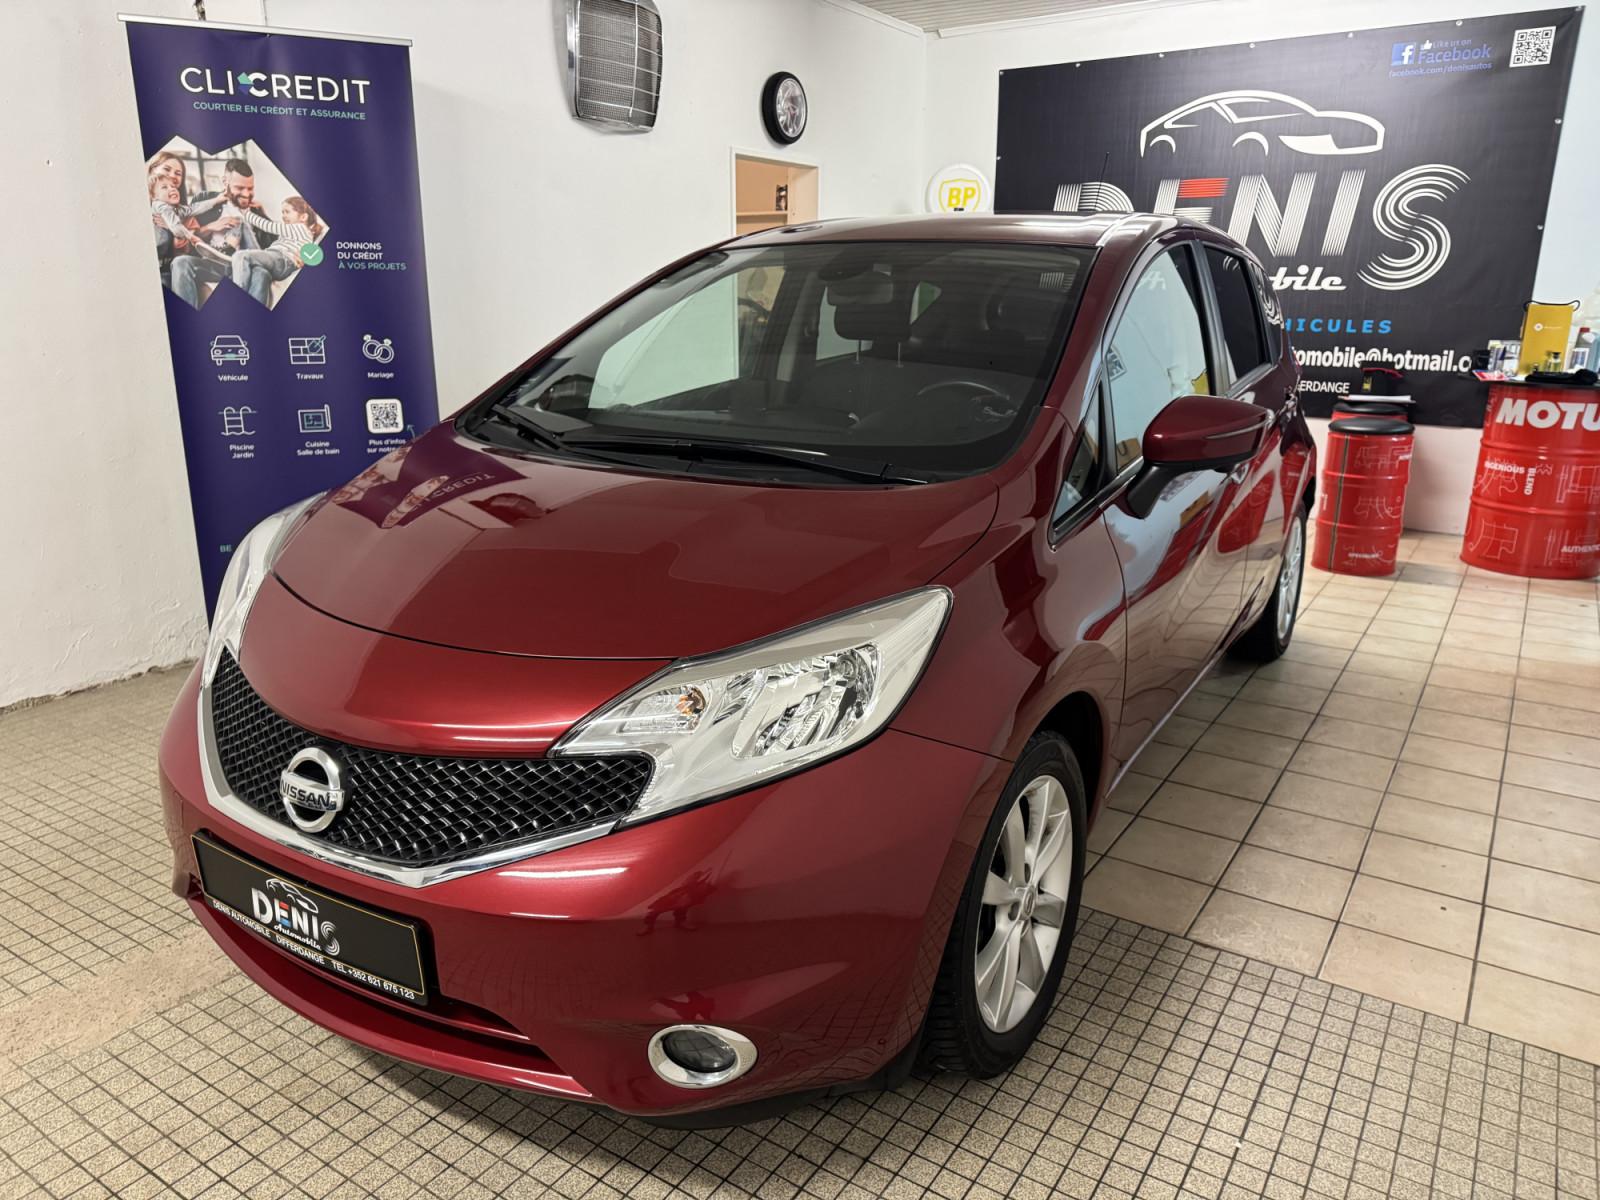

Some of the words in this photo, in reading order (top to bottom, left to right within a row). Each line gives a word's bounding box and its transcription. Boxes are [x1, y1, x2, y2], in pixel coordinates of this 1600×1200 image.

[1418, 43, 1491, 65] Facebook
[1389, 62, 1492, 78] facebook.com/denisautos
[193, 101, 241, 113] COURTIER
[244, 104, 258, 114] EN
[295, 106, 307, 117] ET
[310, 108, 366, 121] ASSURANCE
[948, 187, 977, 208] BP
[336, 241, 382, 250] DONNONS
[337, 251, 351, 260] DU
[338, 260, 346, 270] À
[347, 262, 366, 270] VOS
[367, 262, 407, 271] PROJETS
[296, 372, 324, 380] Travaux
[367, 371, 394, 380] Mariage
[305, 440, 330, 448] Cuisine
[368, 438, 383, 446] Plus
[296, 448, 314, 456] Salle
[314, 448, 324, 456] de
[281, 778, 331, 808] NISSAN
[251, 887, 340, 956] DENIS
[212, 899, 231, 917] DENIS
[231, 910, 272, 939] AUTOMOBILE
[276, 934, 326, 965] DIFFERDANGE
[331, 960, 347, 975] TEL
[348, 968, 368, 982] +352
[367, 975, 381, 988] 621
[383, 981, 399, 994] 675
[400, 988, 415, 1000] 123
